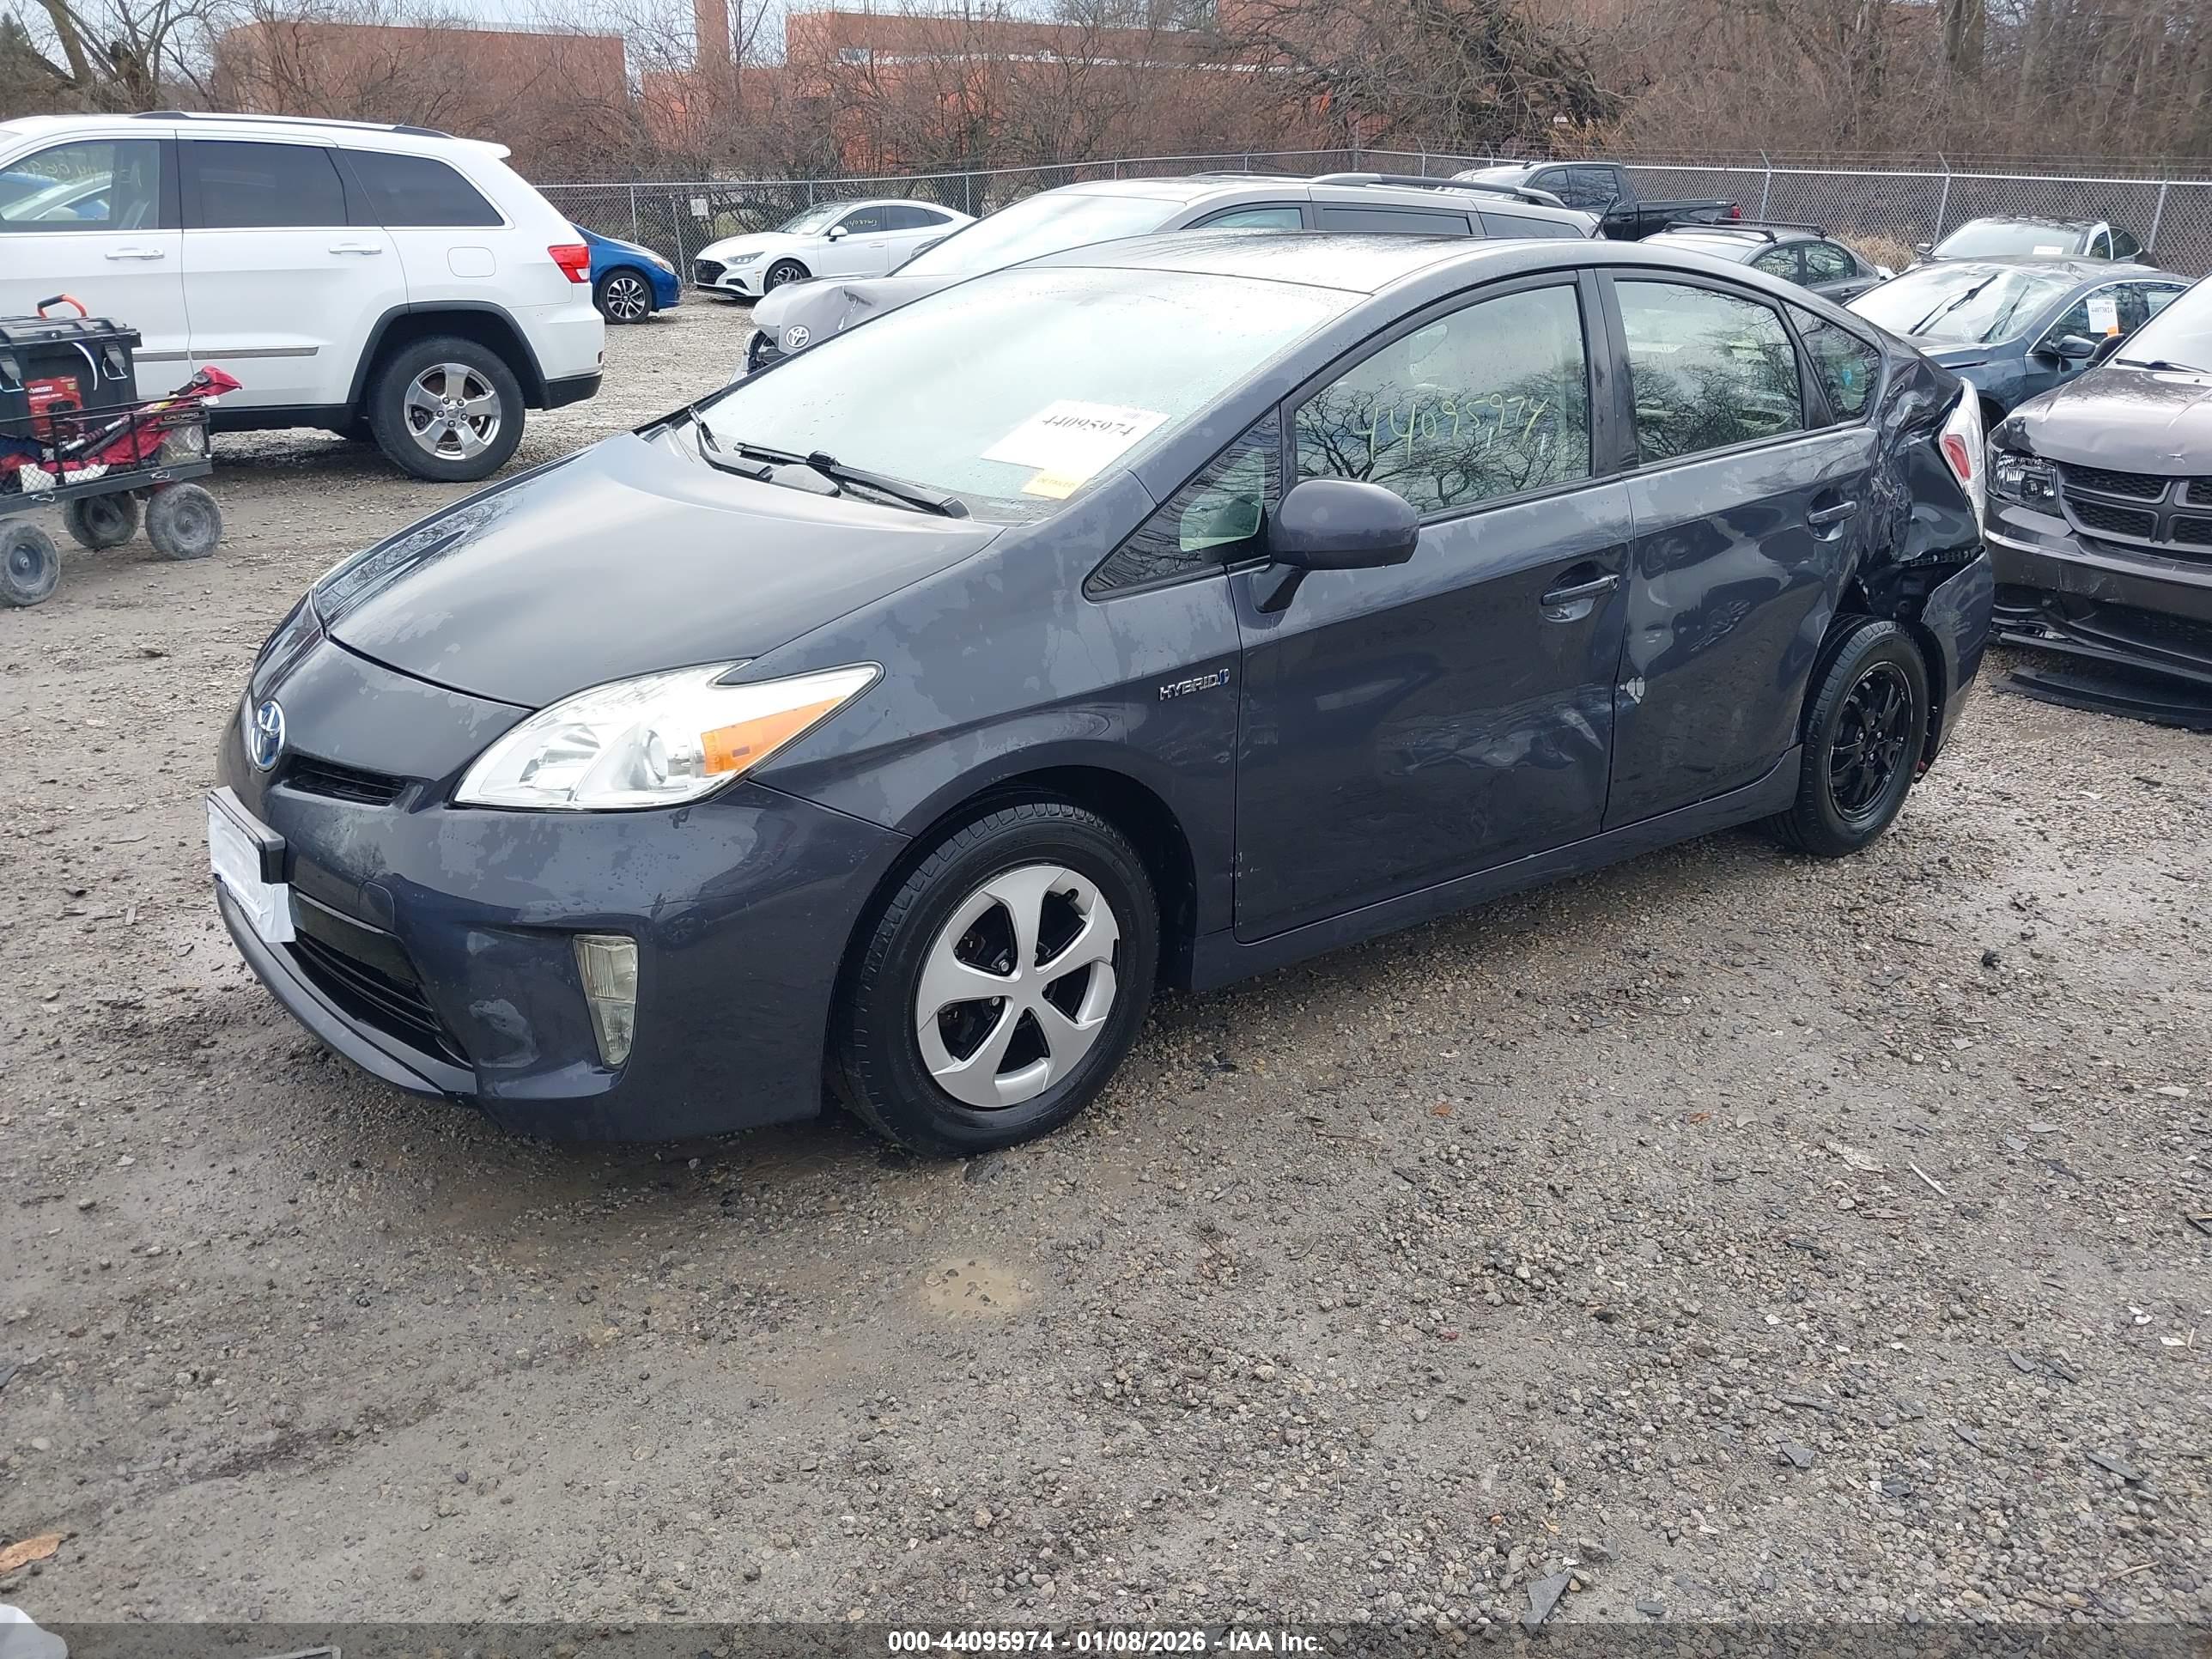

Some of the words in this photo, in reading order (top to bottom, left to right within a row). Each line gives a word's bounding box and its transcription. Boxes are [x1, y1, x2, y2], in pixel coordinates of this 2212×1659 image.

[1042, 415, 1137, 437] 44095974
[1352, 393, 1549, 464] 44095974
[1159, 674, 1219, 701] HYBRID
